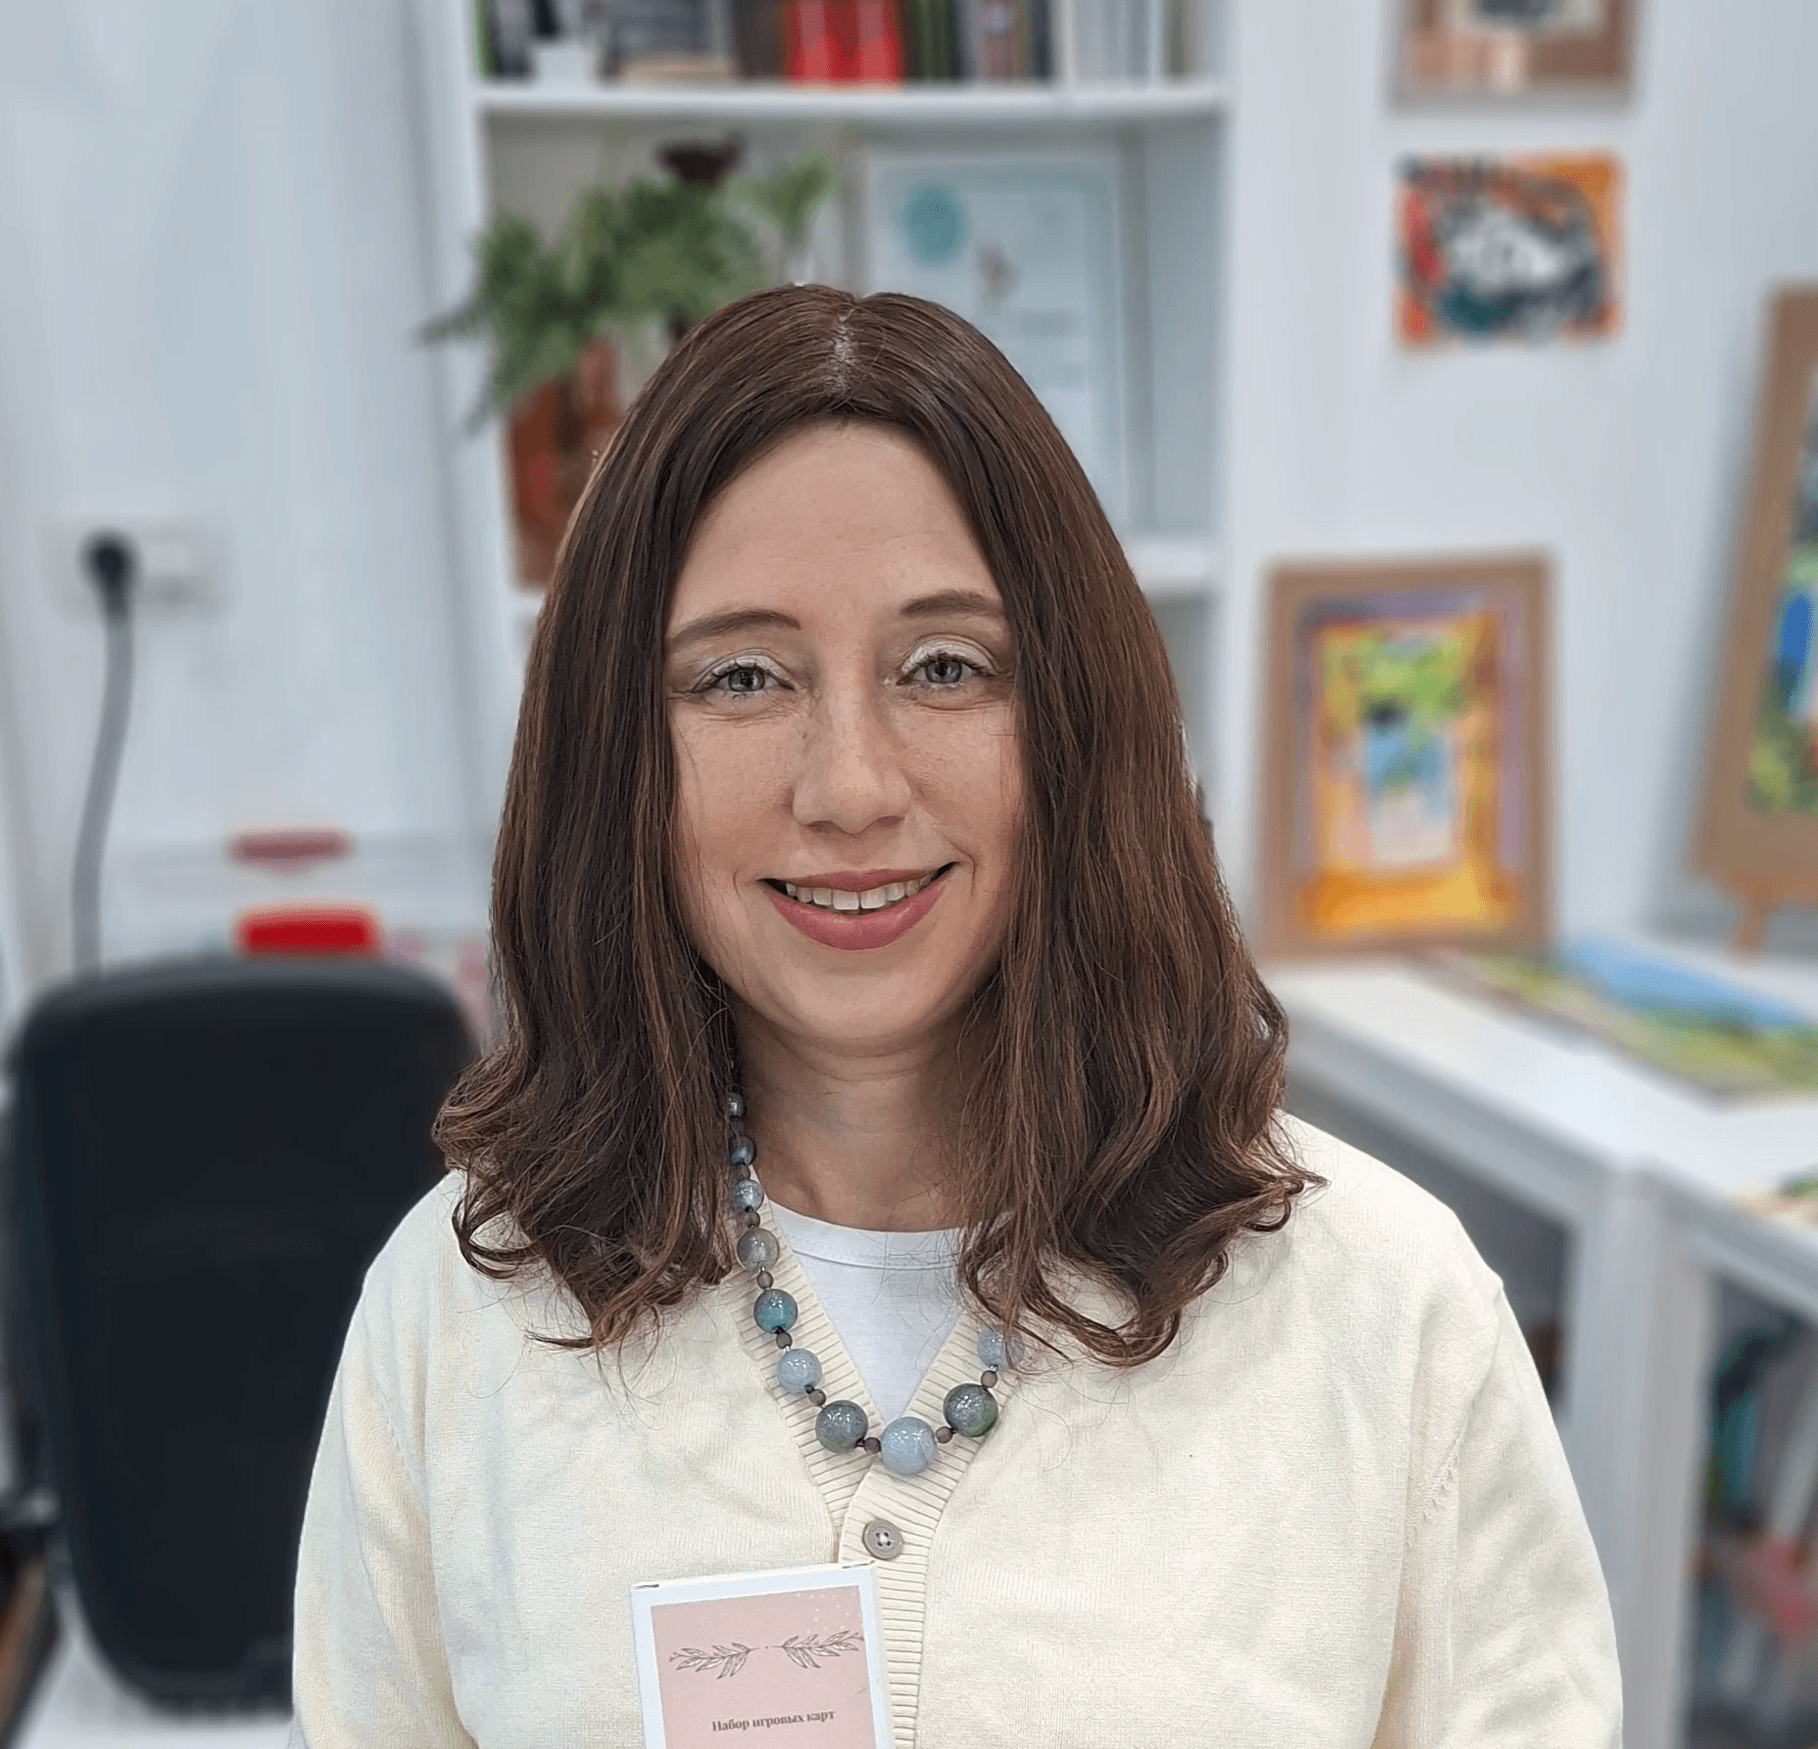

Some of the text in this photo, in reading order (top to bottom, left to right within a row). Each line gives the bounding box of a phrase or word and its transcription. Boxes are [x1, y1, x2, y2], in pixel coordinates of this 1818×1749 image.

[712, 1710, 835, 1731] Набор игровых карт
